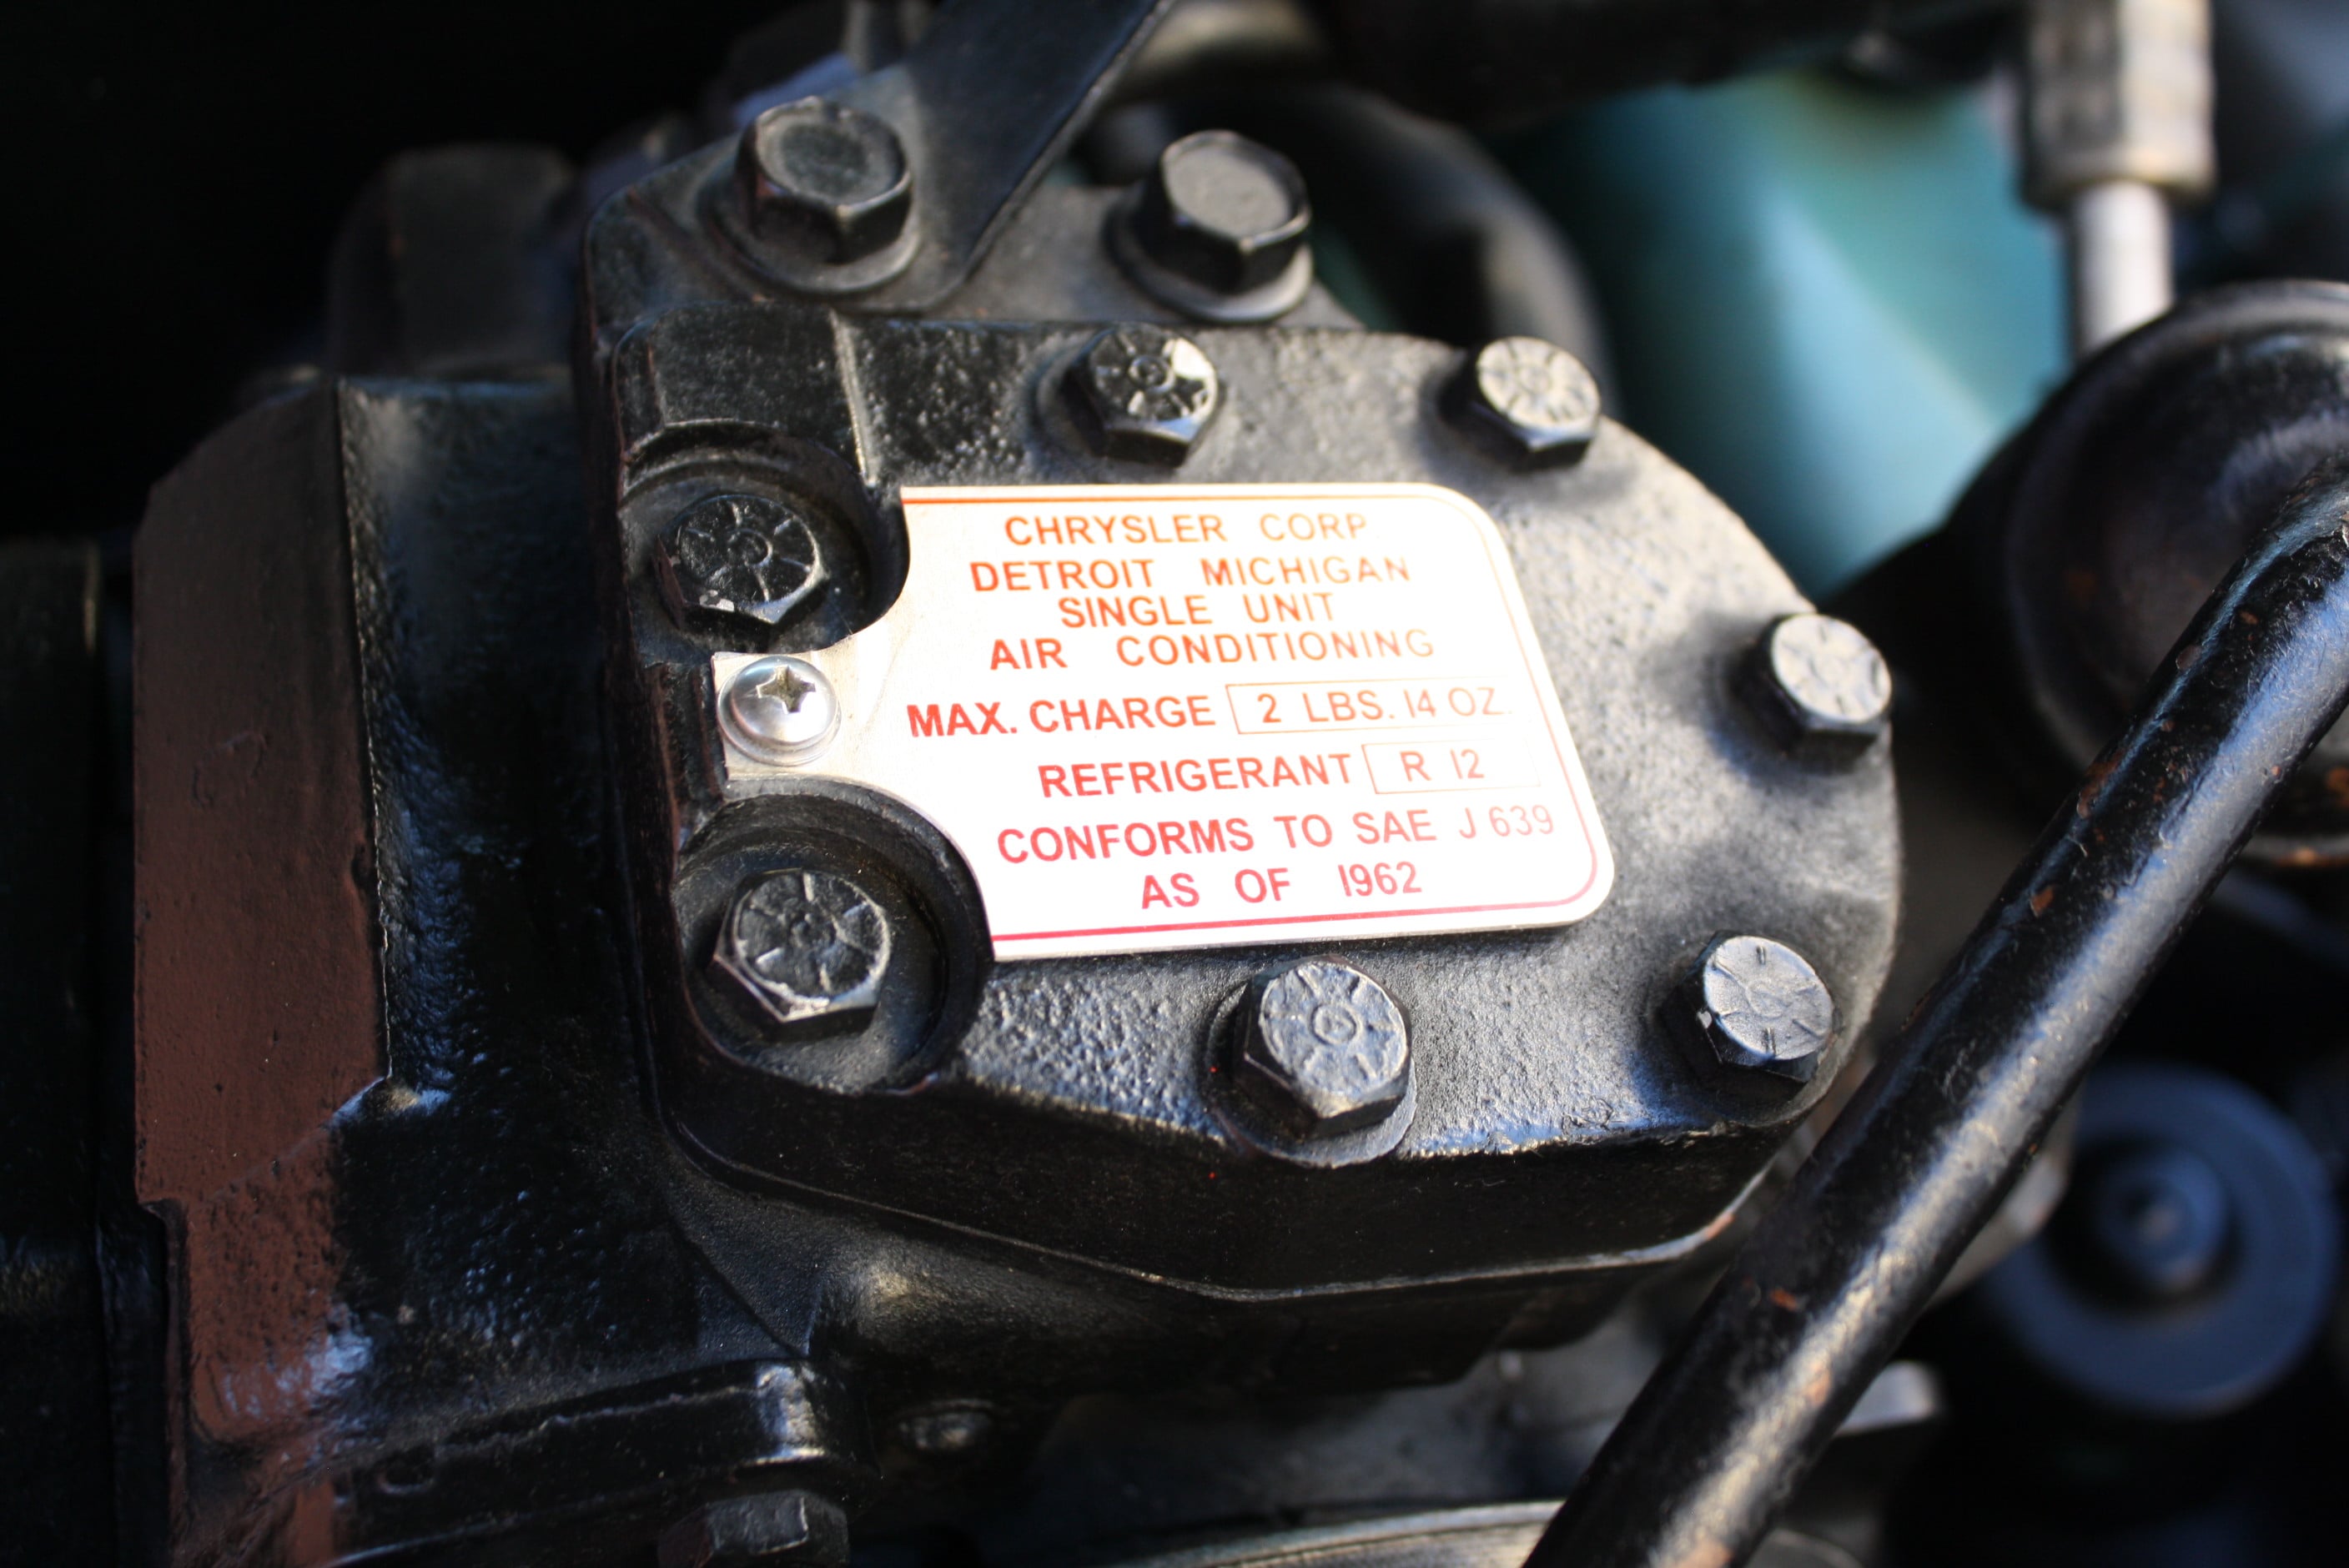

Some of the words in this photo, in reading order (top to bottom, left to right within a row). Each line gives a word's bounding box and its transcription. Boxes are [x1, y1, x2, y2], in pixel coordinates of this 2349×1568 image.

[1003, 513, 1229, 548] CHRYSLER
[1258, 511, 1368, 543] CORP
[968, 557, 1156, 594] DETROIT
[1198, 555, 1412, 588] MICHIGAN
[1056, 593, 1215, 630] SINGLE
[1240, 591, 1335, 625] UNIT
[988, 636, 1069, 672] AIR
[1114, 628, 1435, 668] CONDITIONING
[905, 701, 1019, 739] MAX.
[1028, 694, 1218, 734] CHARGE
[1256, 691, 1283, 725] 2
[1300, 688, 1396, 724] LBS.
[1402, 687, 1437, 720] 14
[1037, 751, 1352, 799] REFRIGERANT
[1398, 749, 1433, 783] R
[1449, 747, 1486, 781] 12
[997, 817, 1255, 865] CONFORMS
[1272, 813, 1334, 849] TO
[1351, 807, 1439, 846] SAE
[1458, 807, 1477, 840] J
[1487, 804, 1554, 837] 639
[1140, 872, 1201, 910] AS
[1234, 867, 1291, 904] OF
[1336, 860, 1423, 898] 1962
